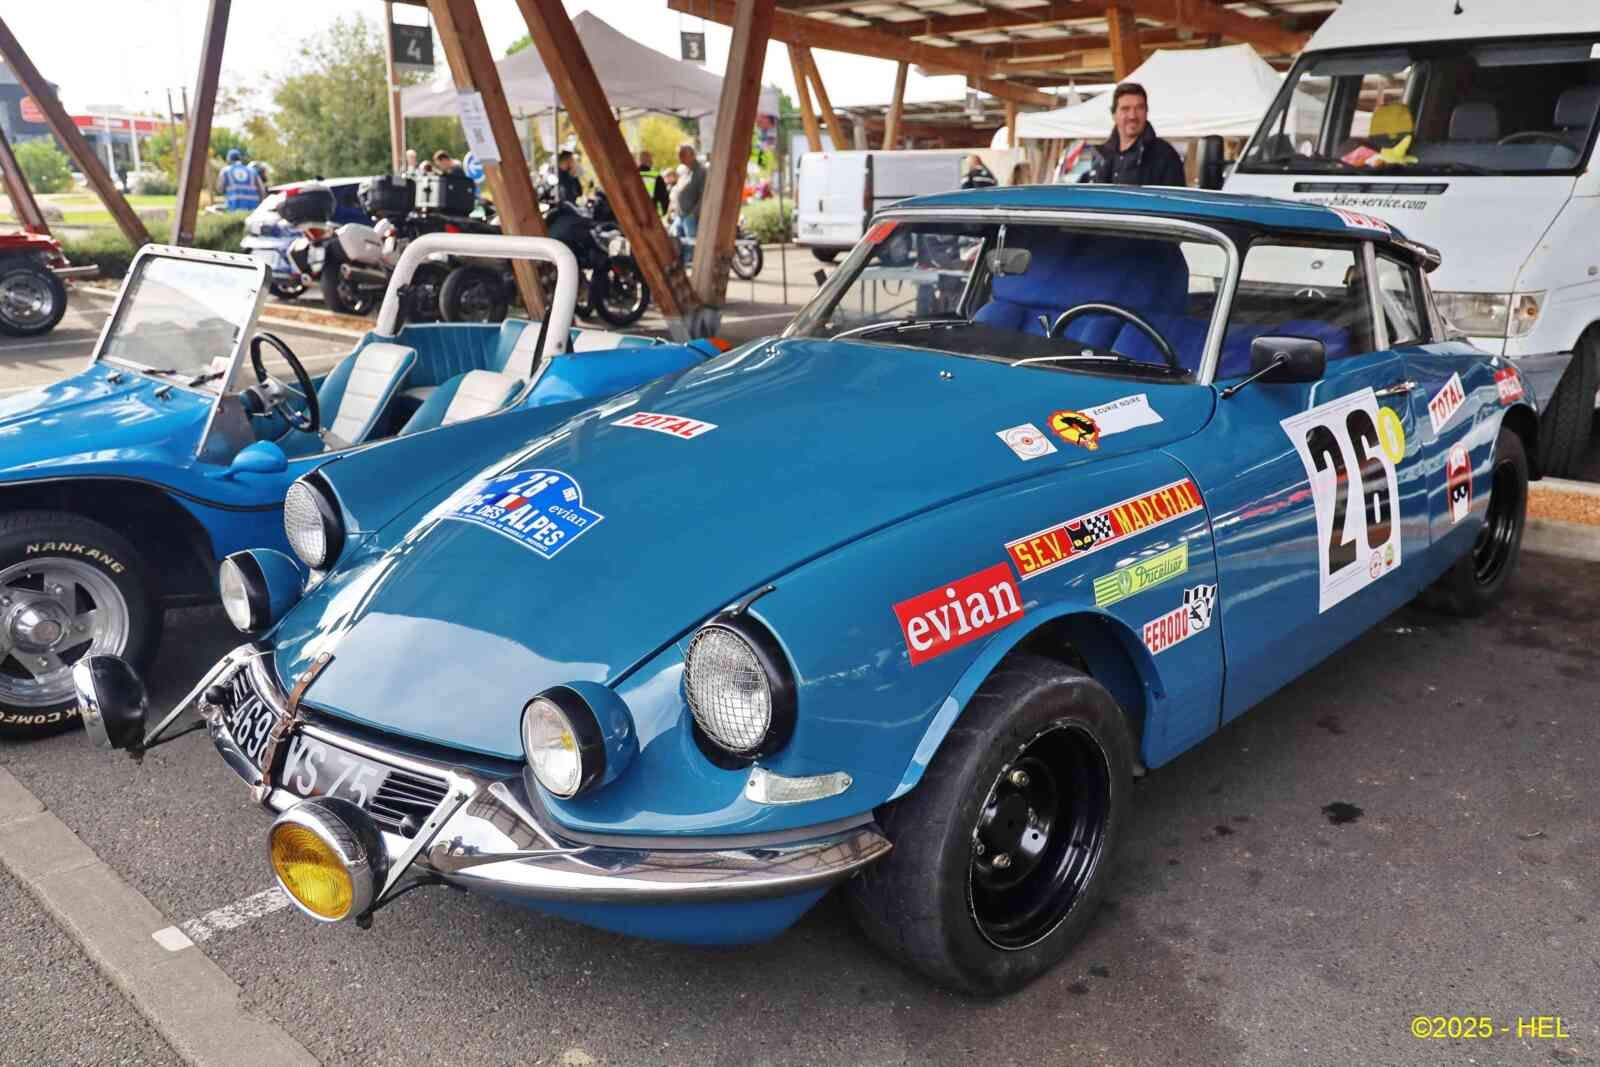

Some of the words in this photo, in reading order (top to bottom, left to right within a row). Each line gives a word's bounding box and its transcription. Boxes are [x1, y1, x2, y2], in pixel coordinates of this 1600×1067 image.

[406, 39, 422, 60] 4
[688, 42, 699, 58] 3
[1430, 382, 1464, 427] TOTAL
[622, 413, 702, 437] TOTAL
[508, 471, 560, 498] 26
[1305, 409, 1393, 575] 26
[479, 504, 506, 520] DES
[499, 503, 565, 546] ALPES
[547, 504, 588, 528] evian
[1014, 537, 1068, 572] S.E.V.
[1113, 483, 1200, 534] MARCHAL
[25, 541, 126, 574] NANKANG
[906, 577, 1022, 653] evian
[1142, 612, 1189, 652] FERODO
